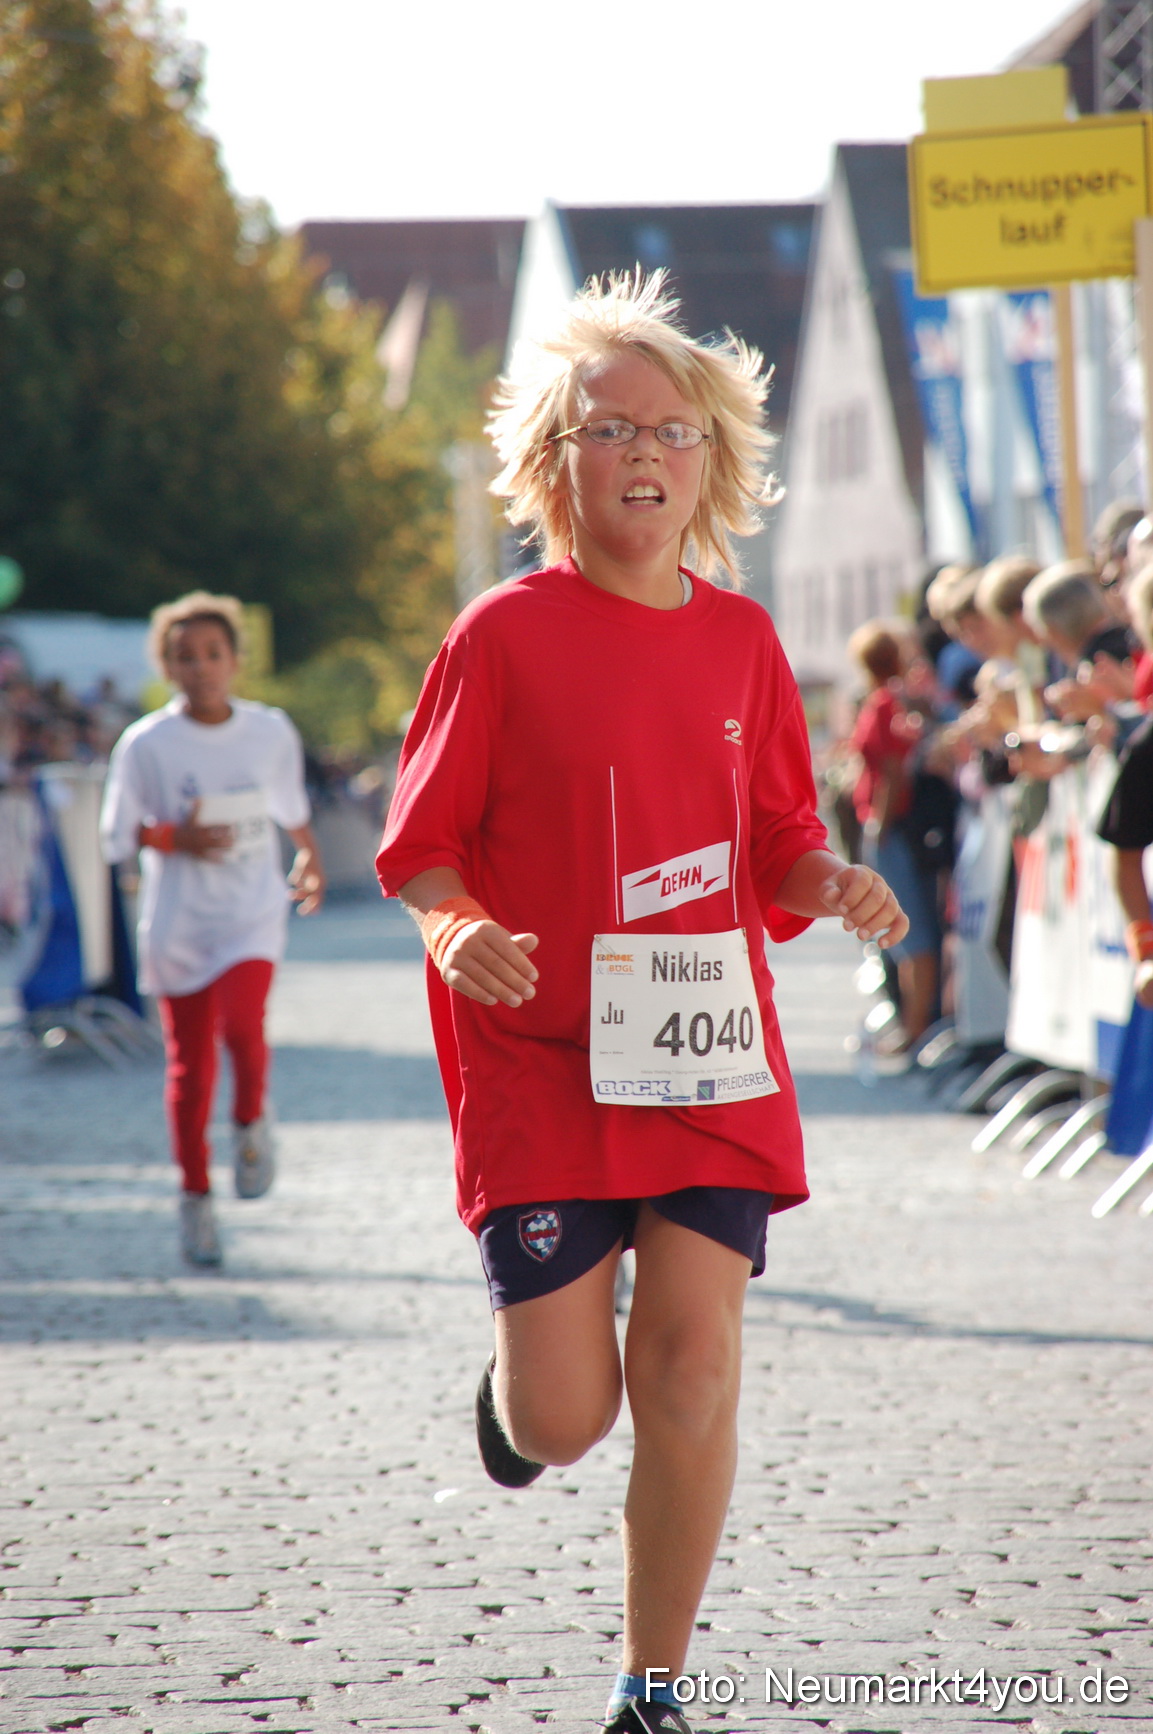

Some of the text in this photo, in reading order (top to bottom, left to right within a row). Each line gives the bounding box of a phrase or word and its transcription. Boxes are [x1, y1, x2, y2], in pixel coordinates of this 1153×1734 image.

[929, 169, 1136, 210] Schnupper-
[999, 211, 1066, 246] lauf
[660, 864, 702, 898] DEHN
[652, 951, 723, 982] Niklas
[601, 1002, 624, 1025] Ju
[653, 1006, 754, 1057] 4040
[596, 1080, 671, 1096] BOCK
[717, 1071, 772, 1092] PFLEIDERER
